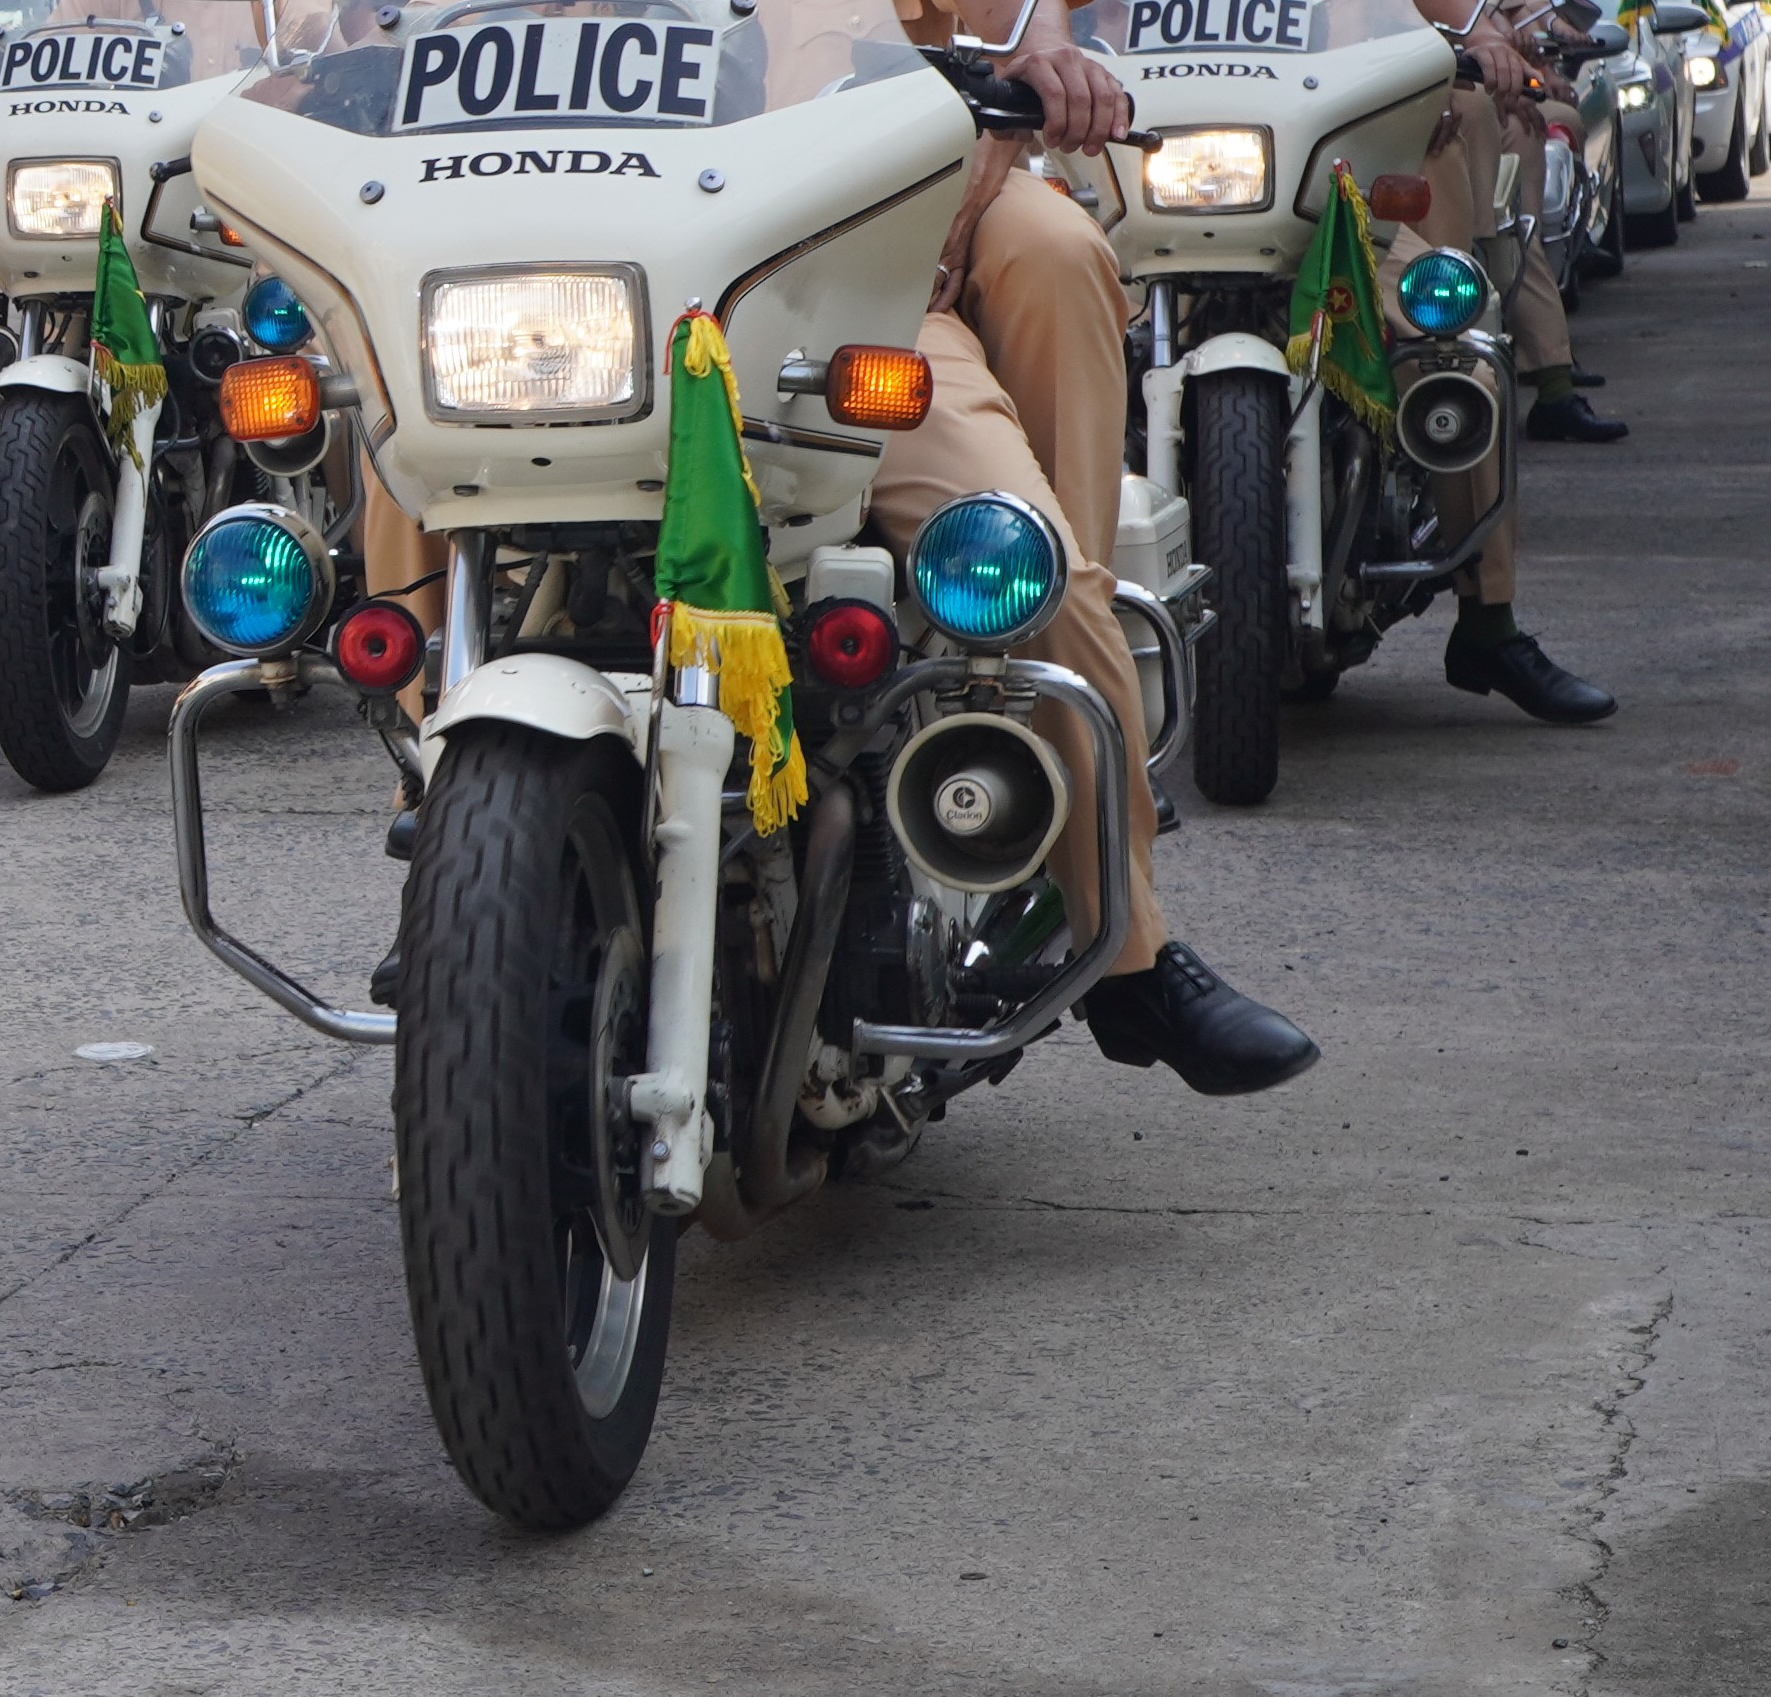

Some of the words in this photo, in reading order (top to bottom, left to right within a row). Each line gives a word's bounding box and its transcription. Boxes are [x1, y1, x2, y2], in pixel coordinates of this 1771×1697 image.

[1, 36, 163, 87] POLICE
[402, 16, 715, 123] POLICE
[1140, 63, 1280, 81] HONDA
[8, 100, 131, 117] HONDA
[419, 149, 661, 183] HONDA
